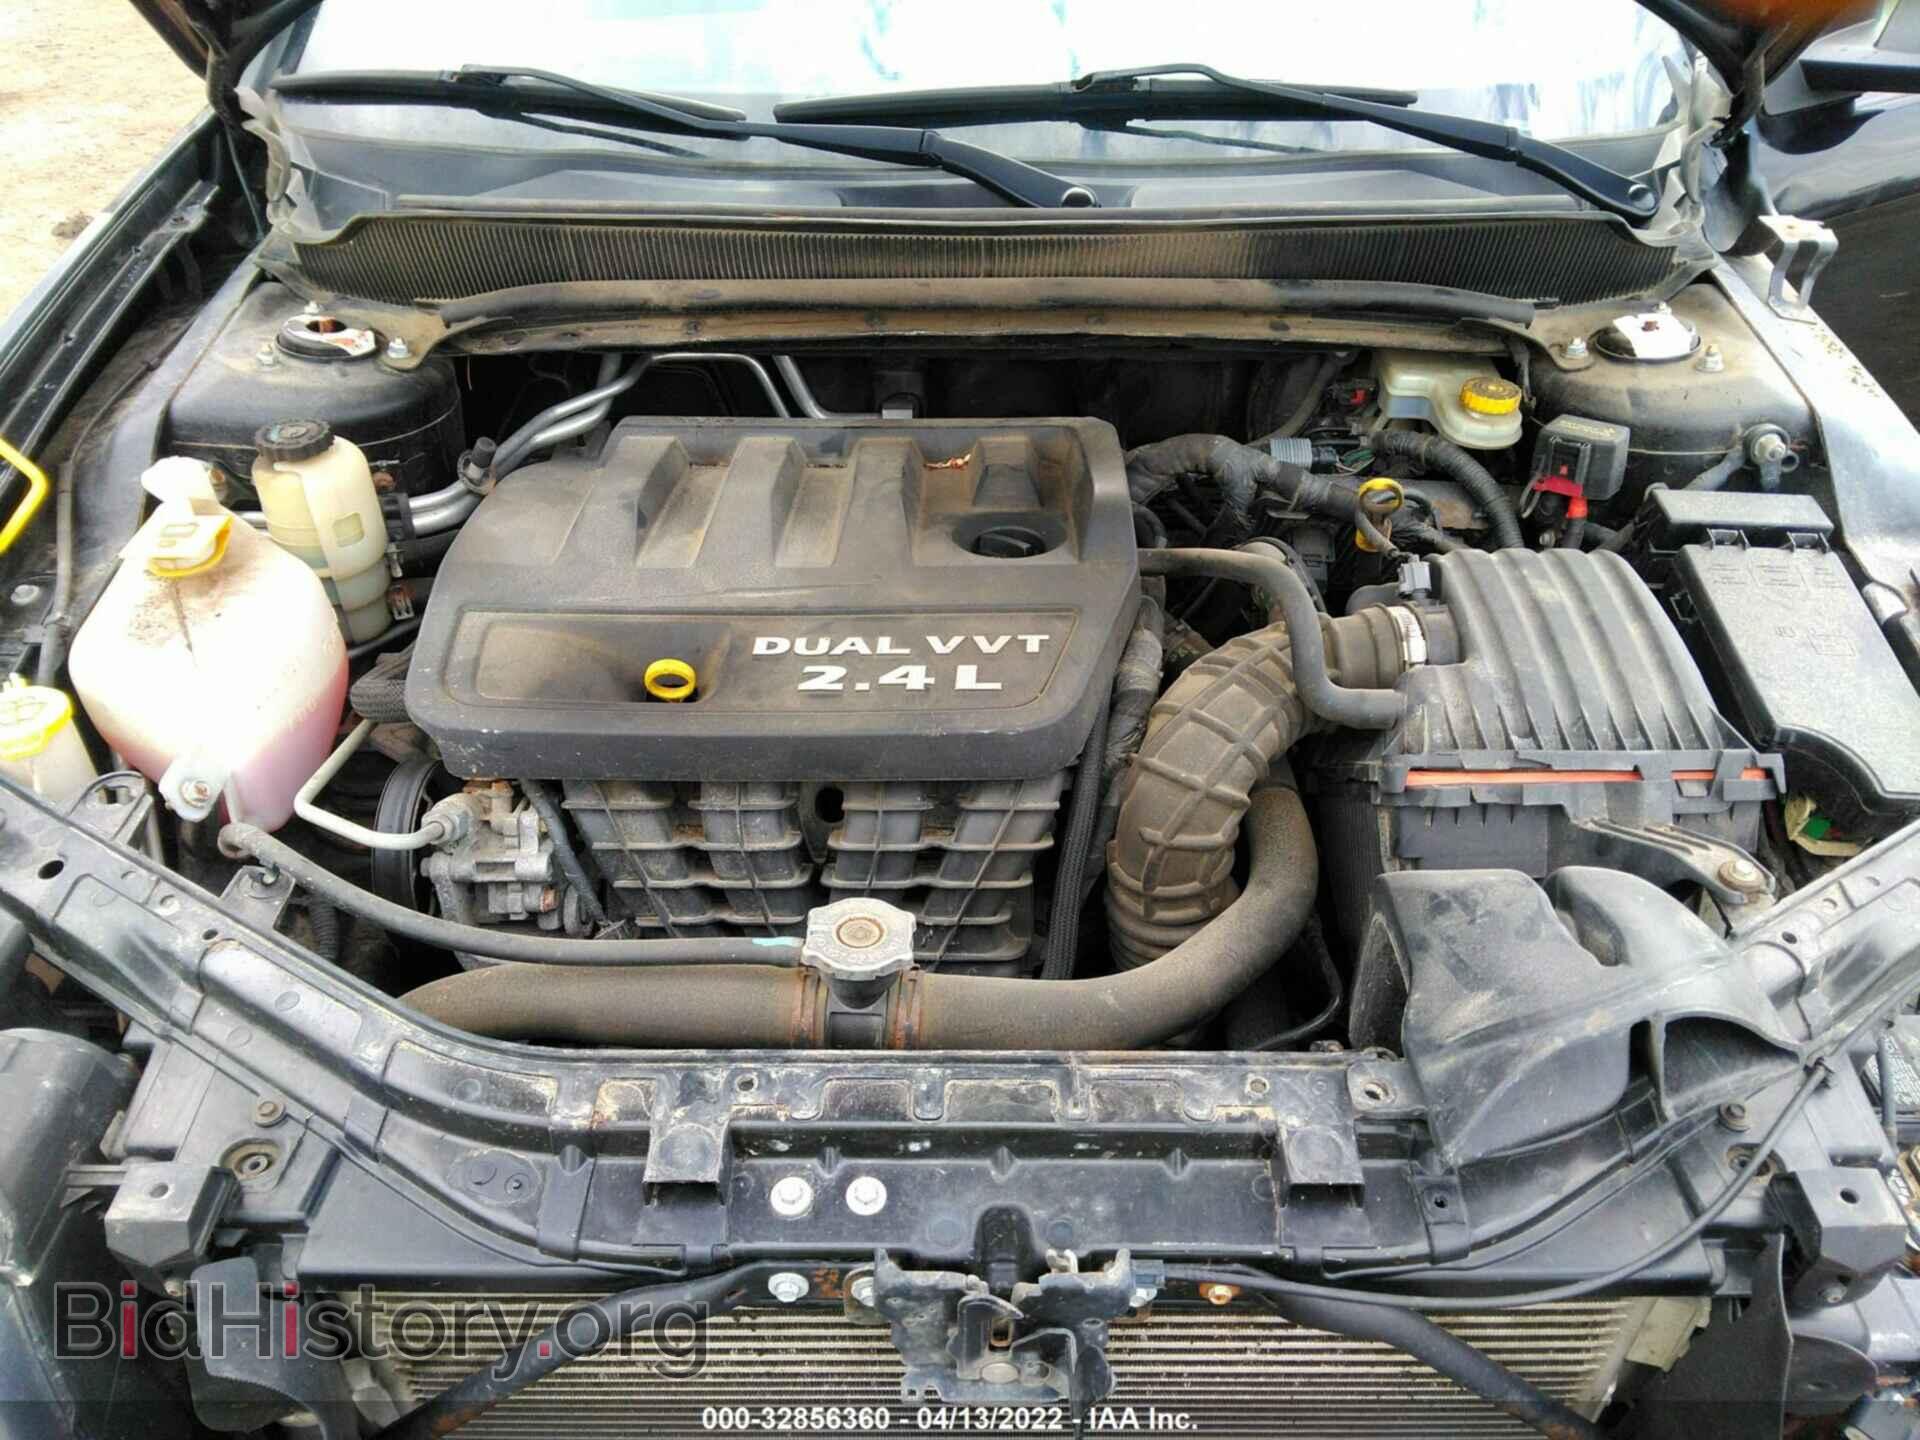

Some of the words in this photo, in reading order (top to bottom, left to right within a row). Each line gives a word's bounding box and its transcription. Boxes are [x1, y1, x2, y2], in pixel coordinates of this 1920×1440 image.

[752, 636, 911, 655] DUAL
[925, 634, 1050, 654] VVT
[797, 664, 936, 691] 2.4
[954, 664, 1003, 691] L
